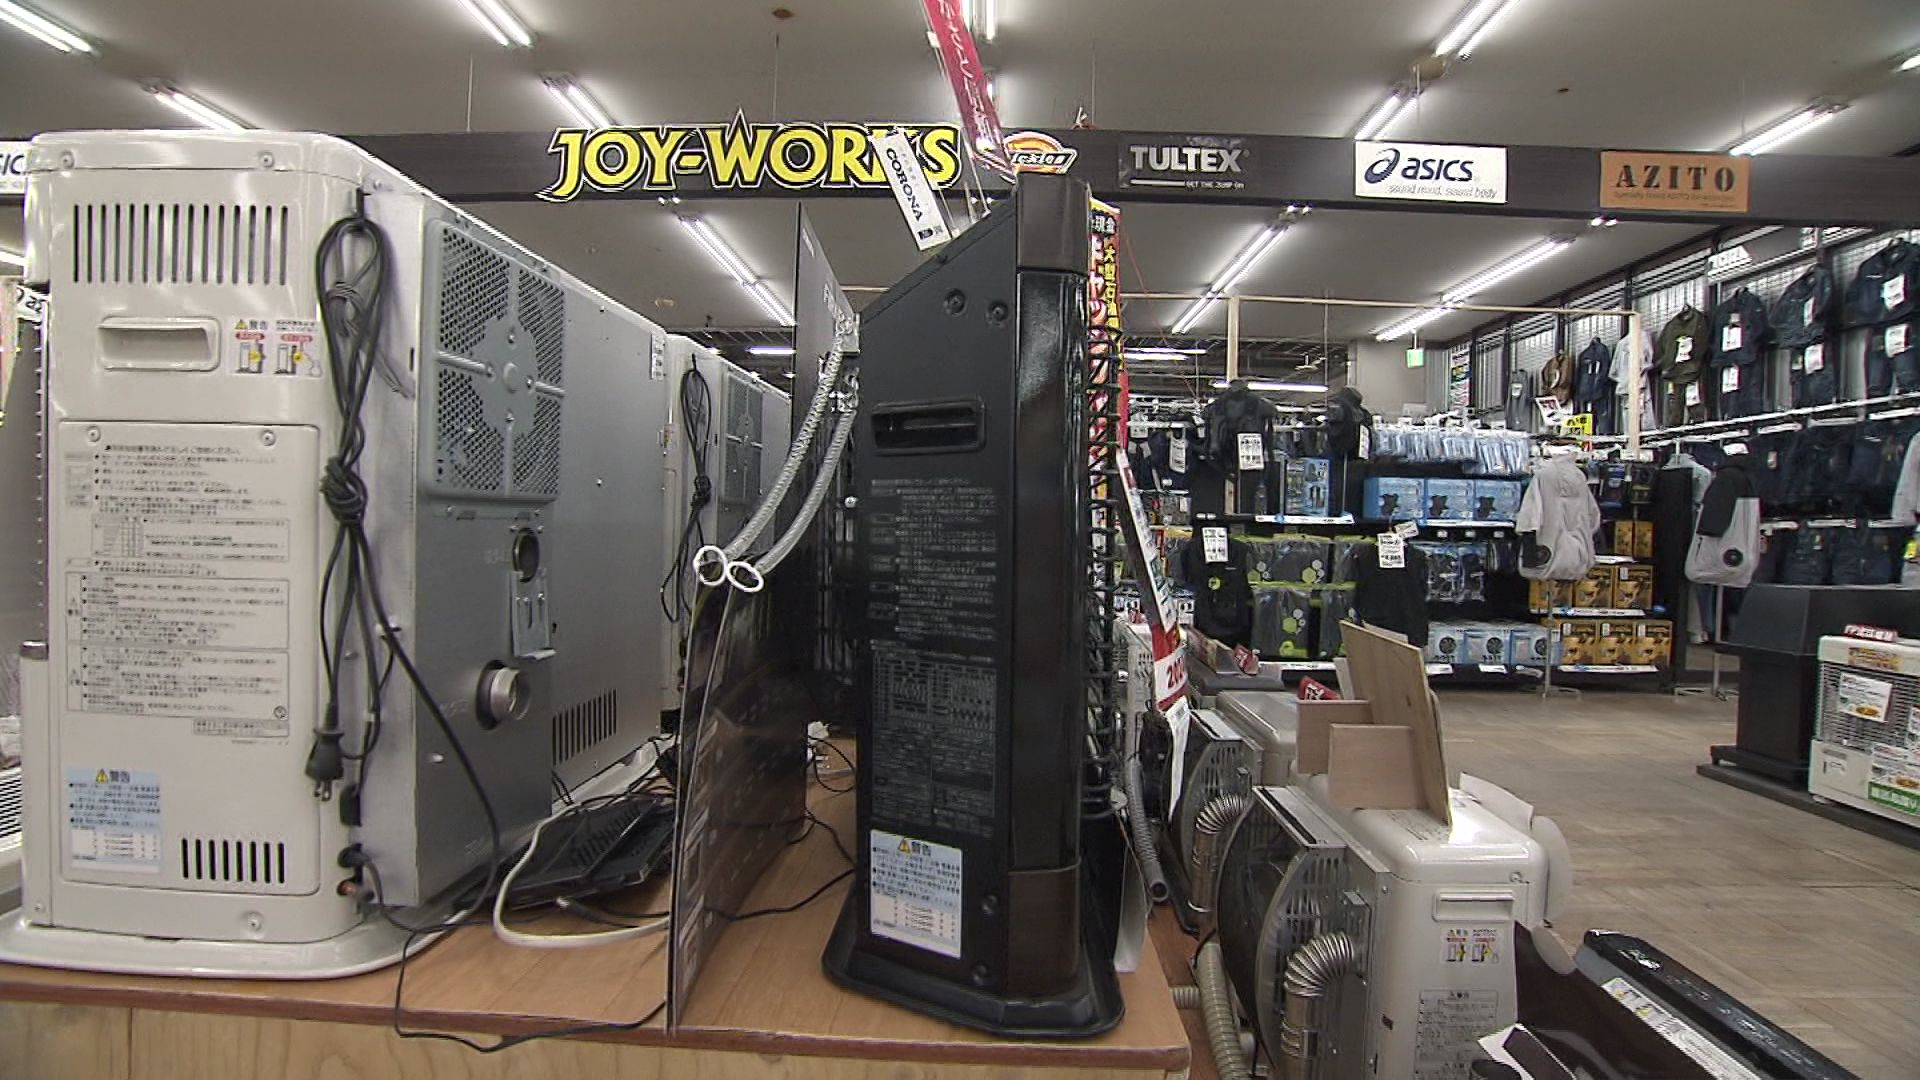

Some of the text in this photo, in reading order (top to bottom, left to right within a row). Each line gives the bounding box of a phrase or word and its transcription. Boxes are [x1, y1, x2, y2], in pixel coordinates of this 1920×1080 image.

[1130, 147, 1242, 172] TULTEX
[886, 148, 923, 221] CORONA
[1616, 165, 1734, 192] AZITO
